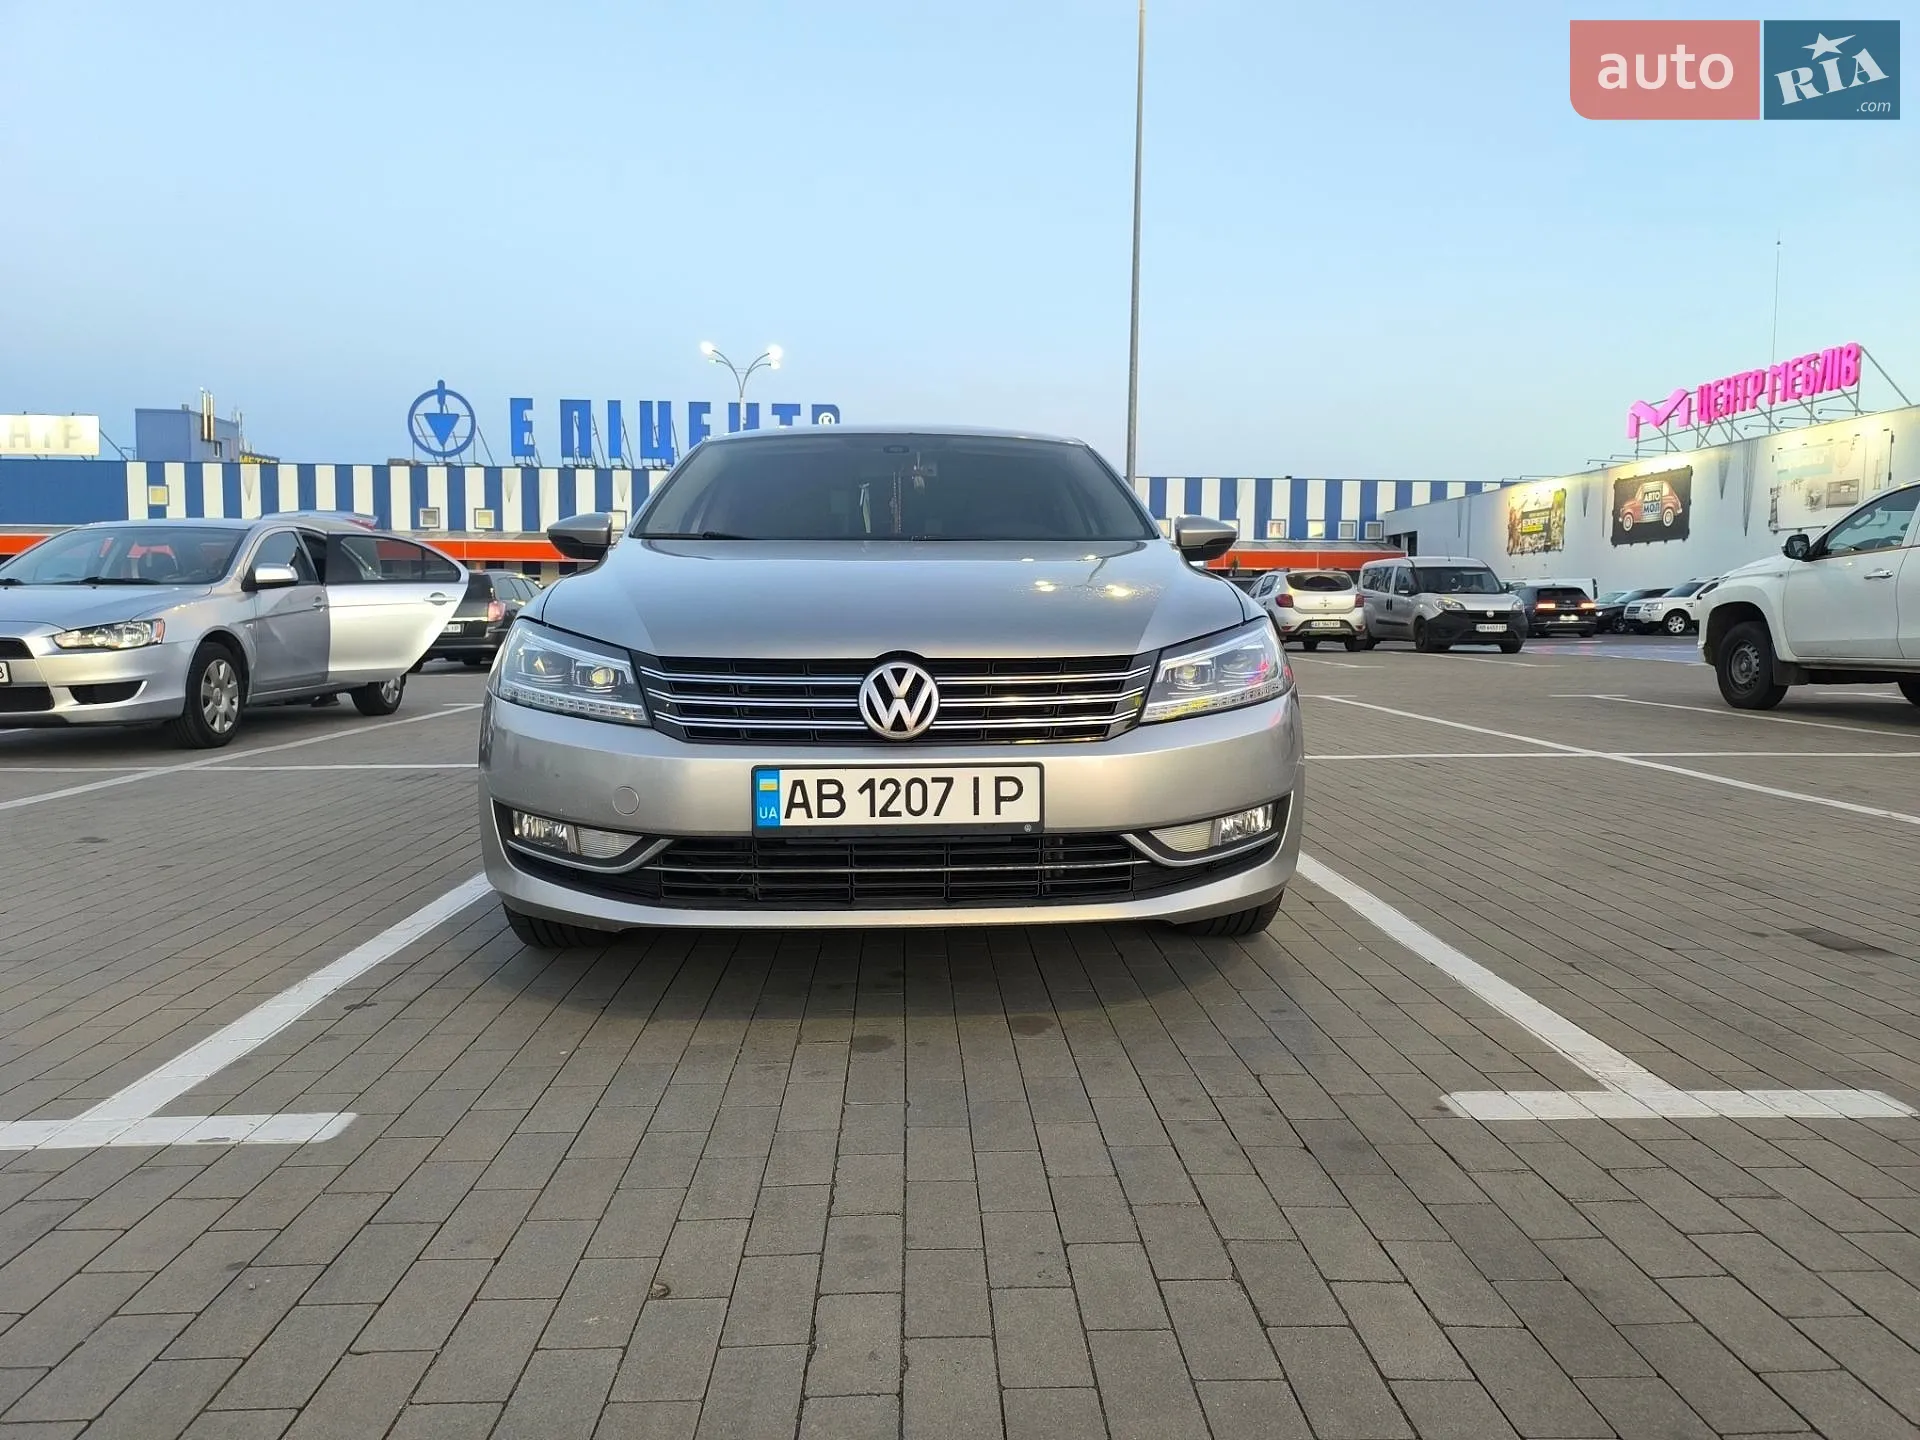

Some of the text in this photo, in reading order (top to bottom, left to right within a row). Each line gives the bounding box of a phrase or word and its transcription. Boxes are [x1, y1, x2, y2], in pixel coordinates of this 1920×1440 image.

[1697, 369, 1766, 424] ЦЕНТР
[1767, 343, 1861, 406] МЕБЛІВ
[759, 806, 778, 820] UA
[784, 775, 1024, 819] AB 1207 IP
